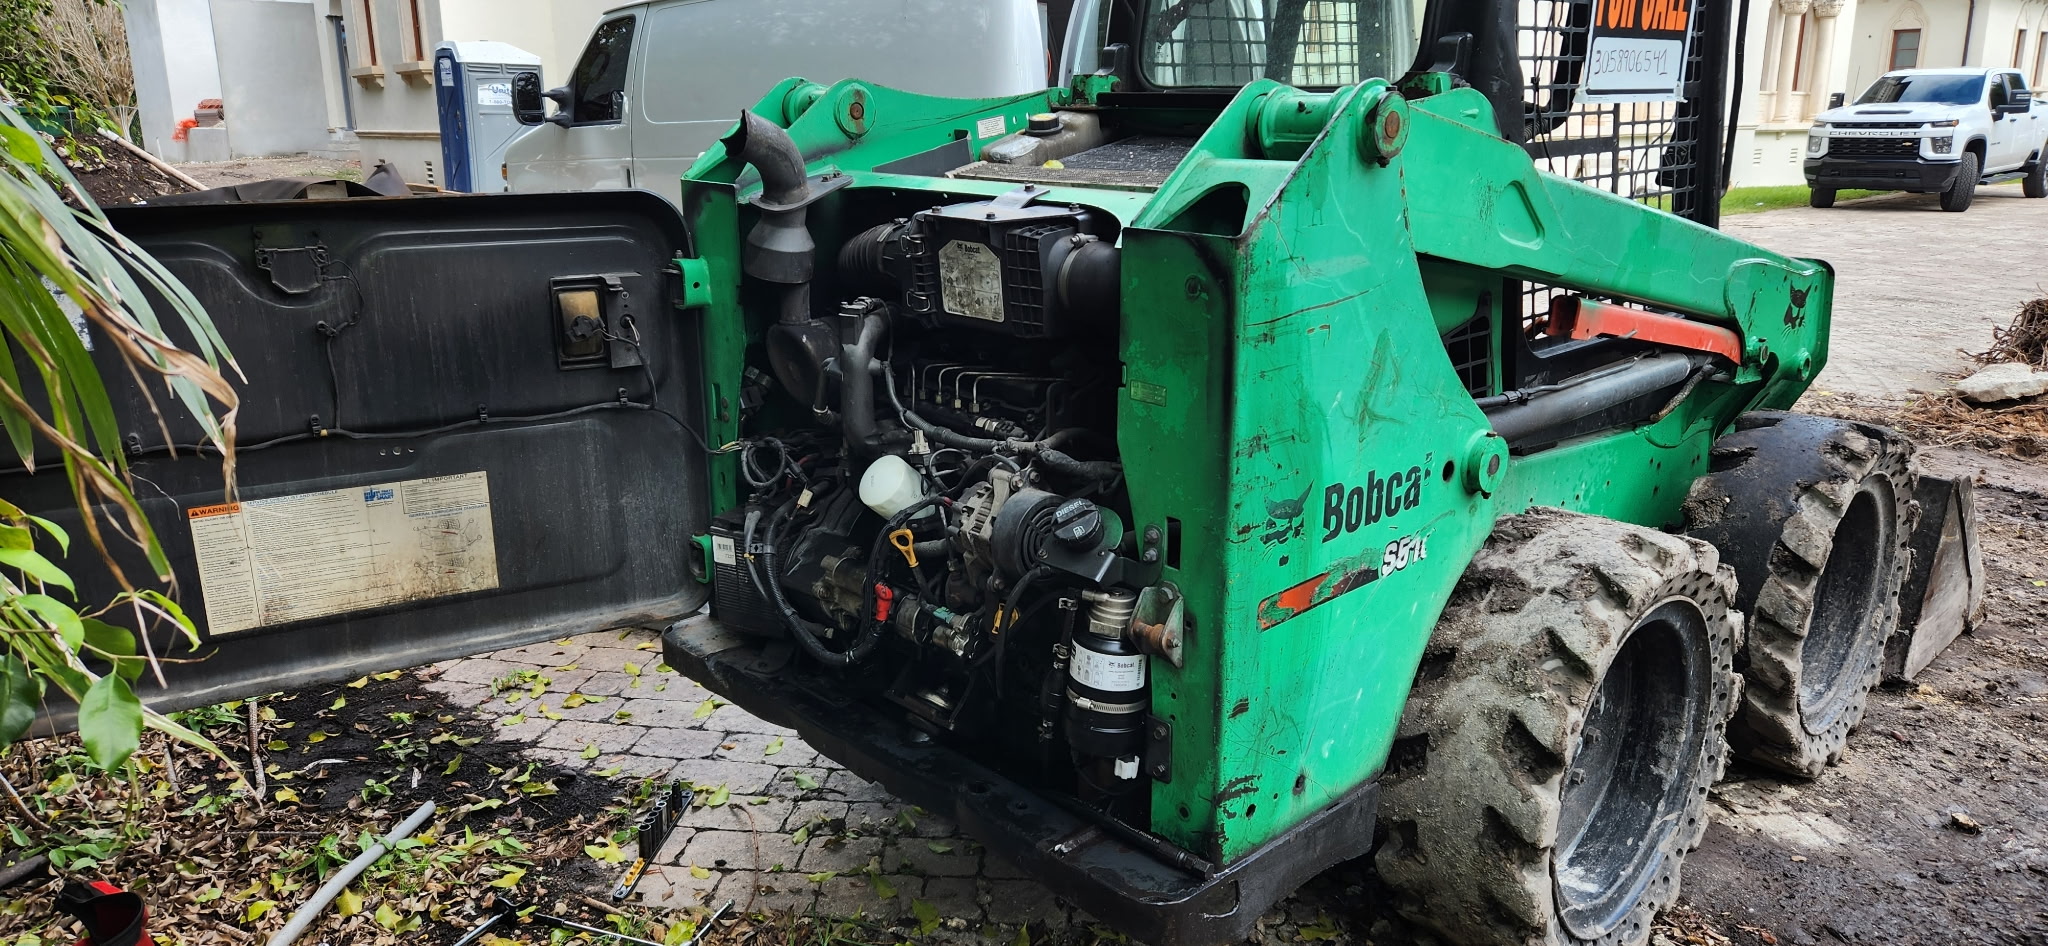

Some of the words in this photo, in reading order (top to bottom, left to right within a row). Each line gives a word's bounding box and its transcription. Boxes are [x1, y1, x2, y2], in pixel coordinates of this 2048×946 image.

[1594, 48, 1667, 75] 3058906541
[431, 473, 467, 483] IMPORTANT
[1055, 500, 1086, 518] DIESEL
[1117, 661, 1135, 669] Bobcat
